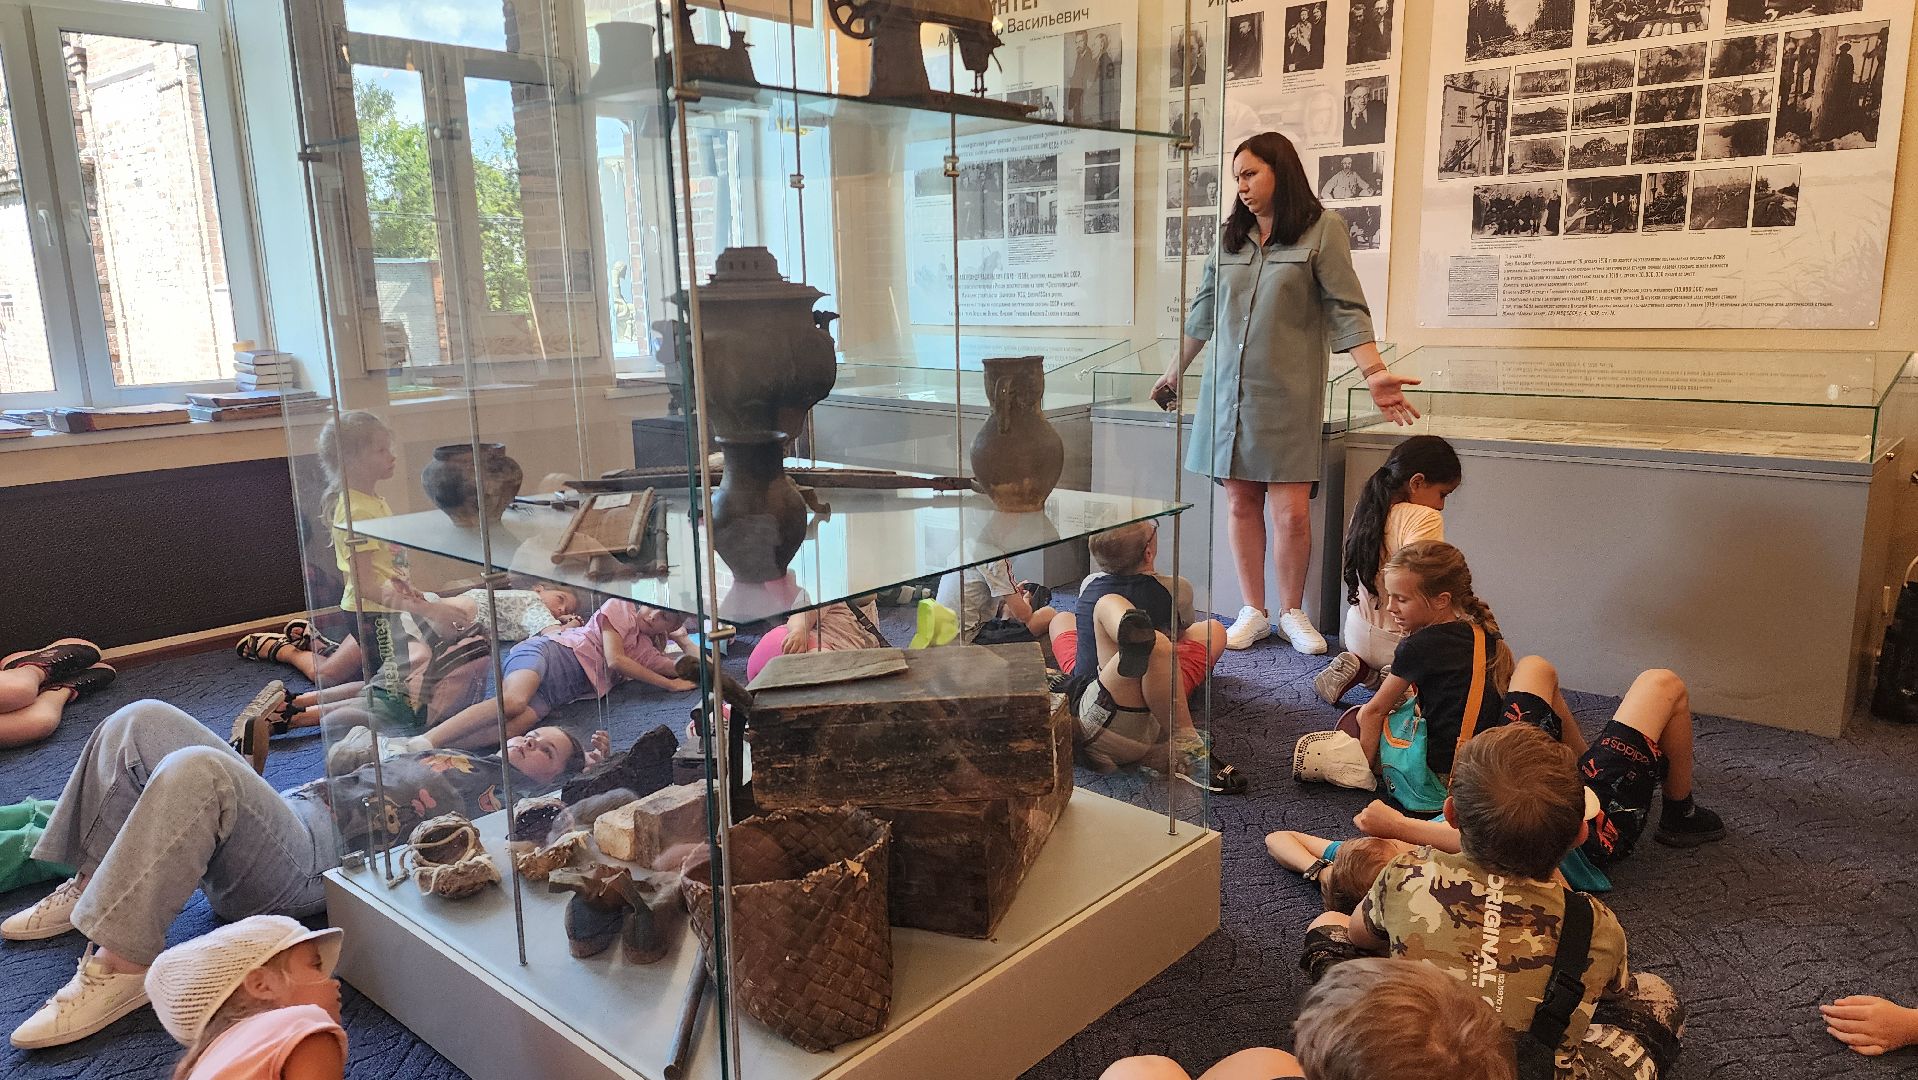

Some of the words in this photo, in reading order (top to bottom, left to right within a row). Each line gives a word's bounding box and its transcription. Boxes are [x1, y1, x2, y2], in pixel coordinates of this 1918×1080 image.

[1007, 7, 1090, 34] Васильевич
[1610, 738, 1650, 765] adidas
[1478, 874, 1505, 988] ORIGINAL
